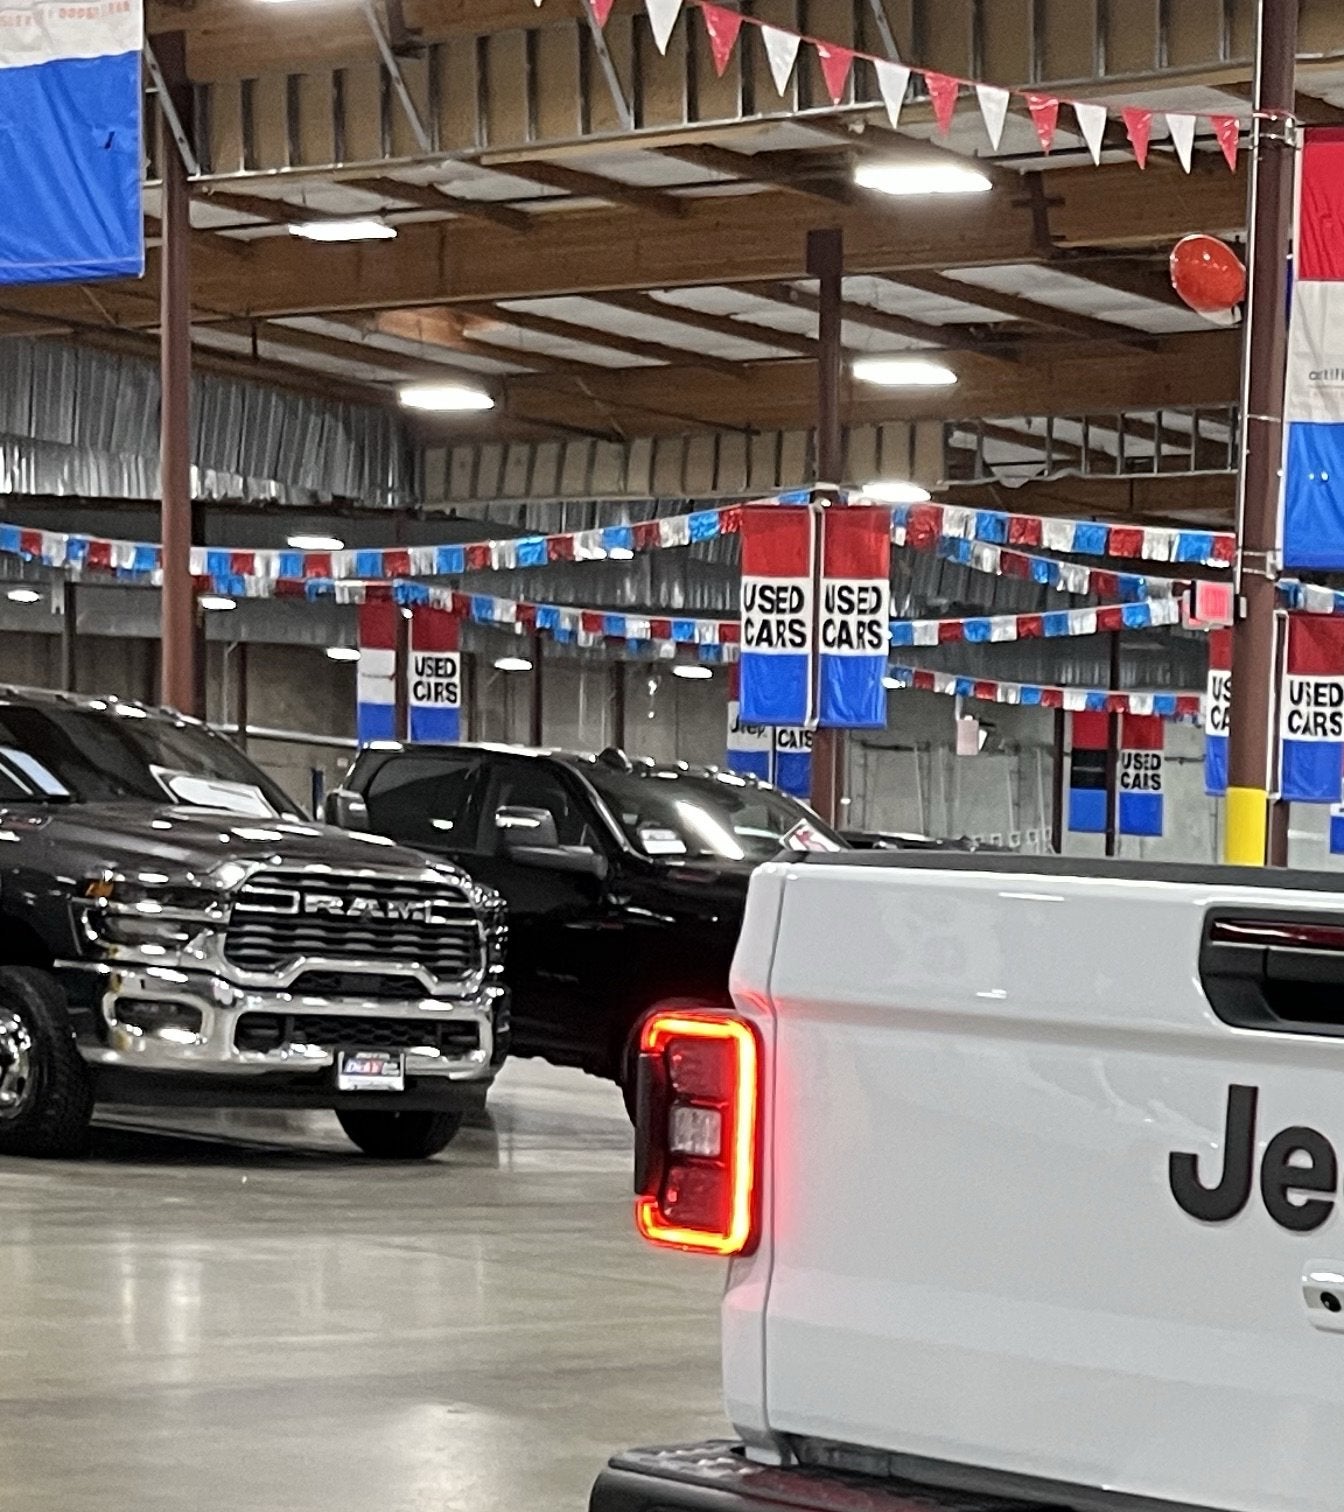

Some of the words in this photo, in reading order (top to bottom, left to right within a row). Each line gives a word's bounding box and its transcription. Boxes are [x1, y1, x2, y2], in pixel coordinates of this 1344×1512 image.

[743, 584, 805, 614] USED
[825, 585, 882, 615] USED
[744, 618, 807, 648] CARS
[822, 618, 882, 650] CARS
[415, 656, 457, 678] USED
[1212, 676, 1231, 702] US
[1289, 681, 1344, 707] USED
[1287, 709, 1343, 736] CARS
[1121, 752, 1161, 771] USED
[304, 893, 424, 920] RAM
